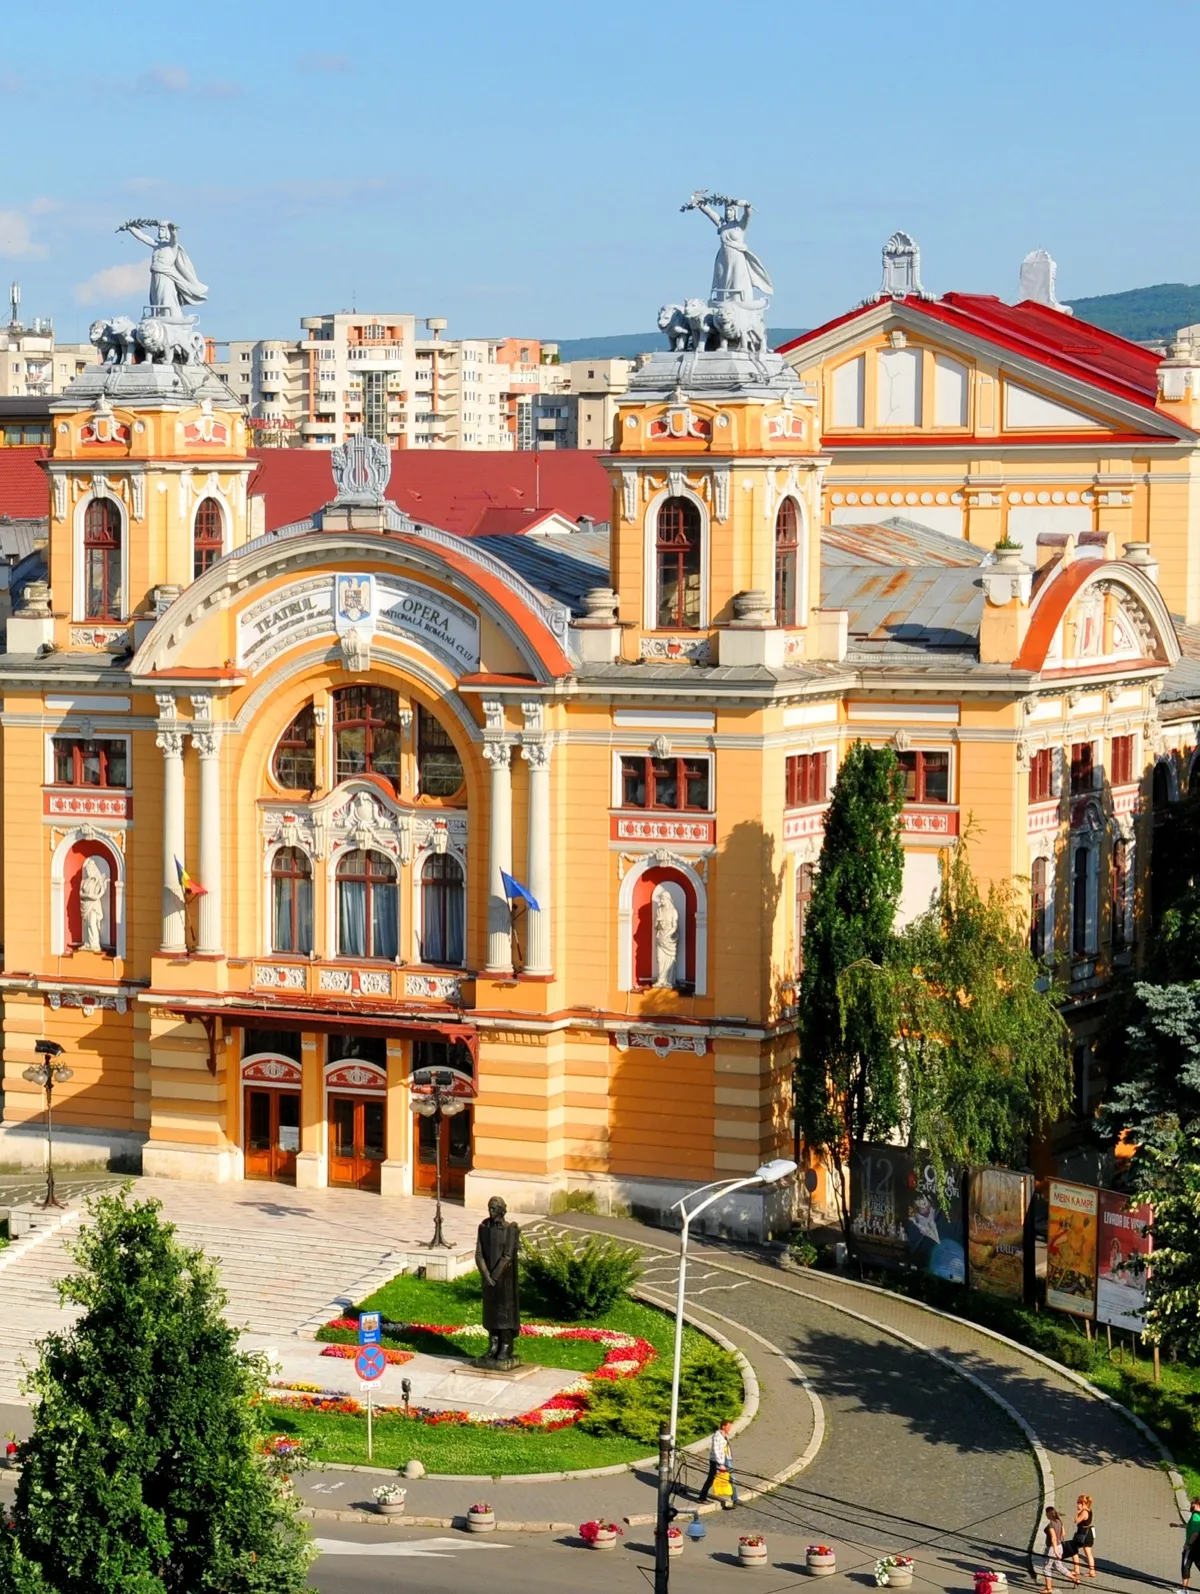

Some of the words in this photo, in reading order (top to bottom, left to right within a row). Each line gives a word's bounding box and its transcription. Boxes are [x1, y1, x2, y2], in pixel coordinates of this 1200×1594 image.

[253, 597, 317, 634] TEATRUL
[402, 599, 449, 631] OPERA
[861, 1156, 894, 1194] 12
[1053, 1192, 1070, 1203] MEIN
[1071, 1196, 1094, 1208] KAMPF
